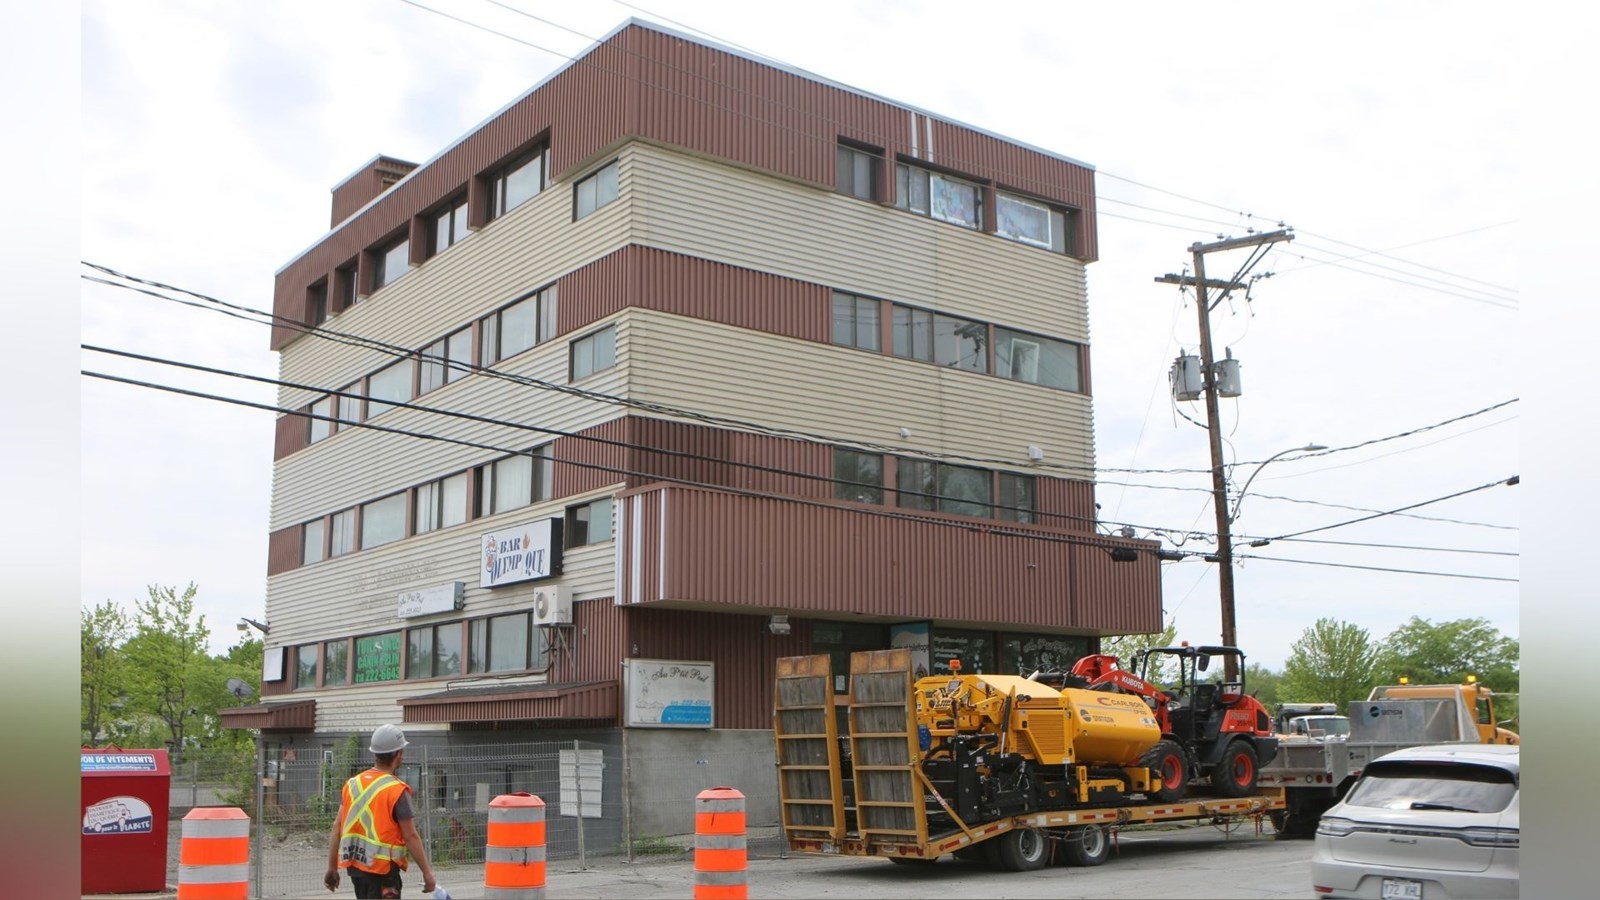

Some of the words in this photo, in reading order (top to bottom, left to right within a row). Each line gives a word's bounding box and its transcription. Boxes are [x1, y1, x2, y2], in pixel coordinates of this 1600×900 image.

[500, 538, 520, 554] BAR
[491, 549, 545, 584] OLYMPQUE
[652, 667, 668, 681] Au
[1122, 675, 1144, 690] KUBOTA
[1110, 699, 1144, 709] CARLSON
